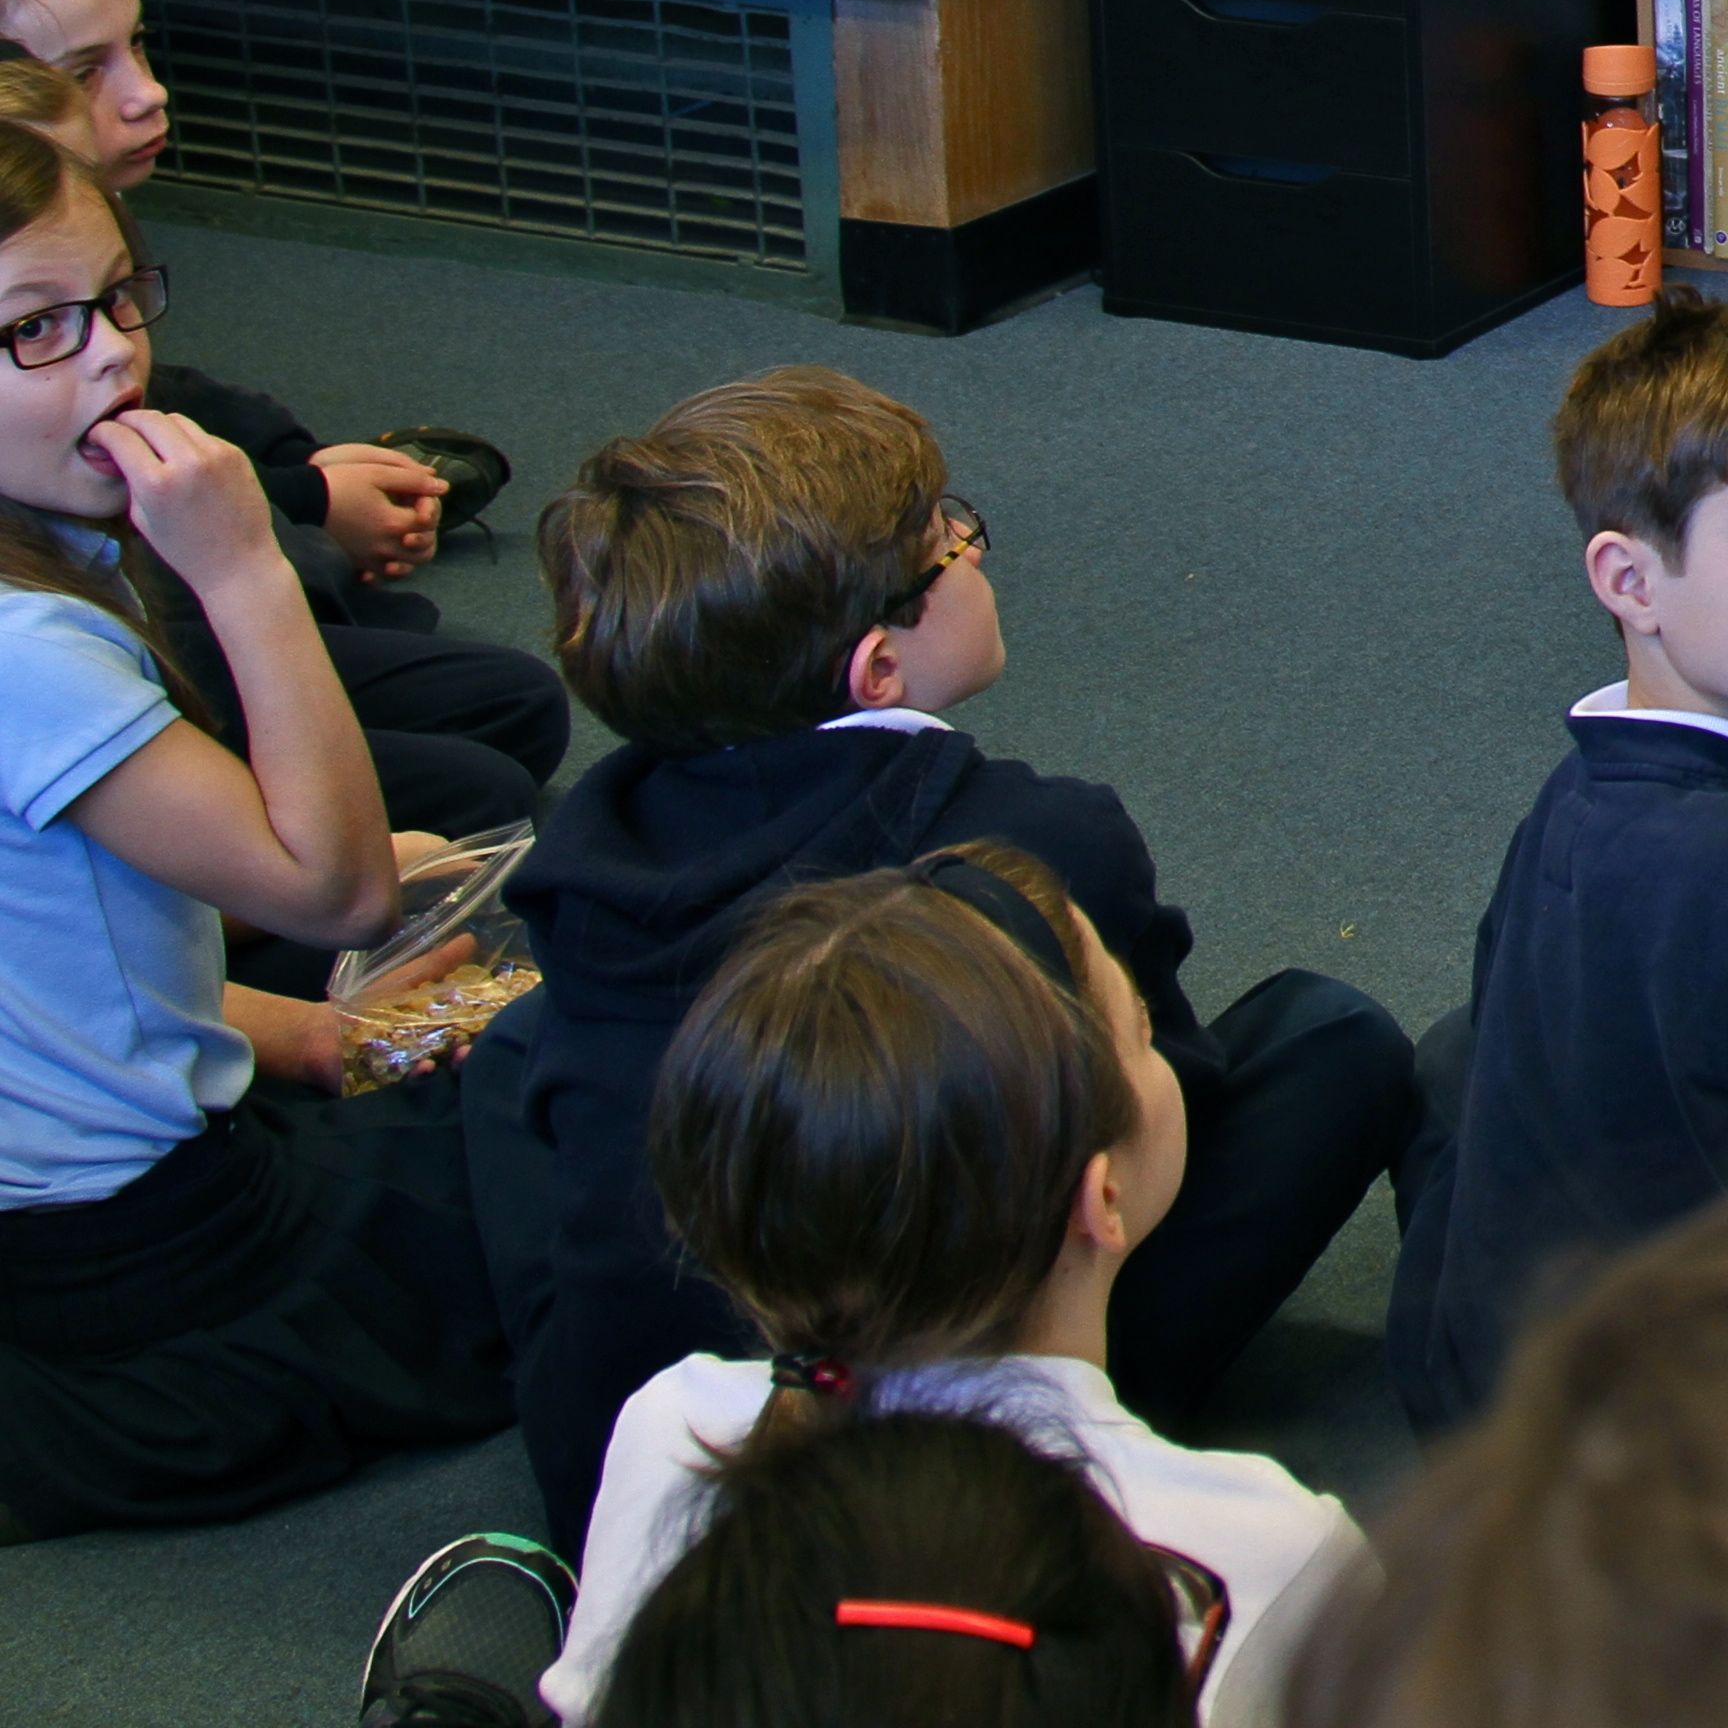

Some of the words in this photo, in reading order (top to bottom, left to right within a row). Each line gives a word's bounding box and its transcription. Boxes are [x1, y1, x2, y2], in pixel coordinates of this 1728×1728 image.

[1692, 10, 1701, 23] OF
[1693, 26, 1702, 84] LANGUAGES
[1716, 48, 1728, 94] ancient
